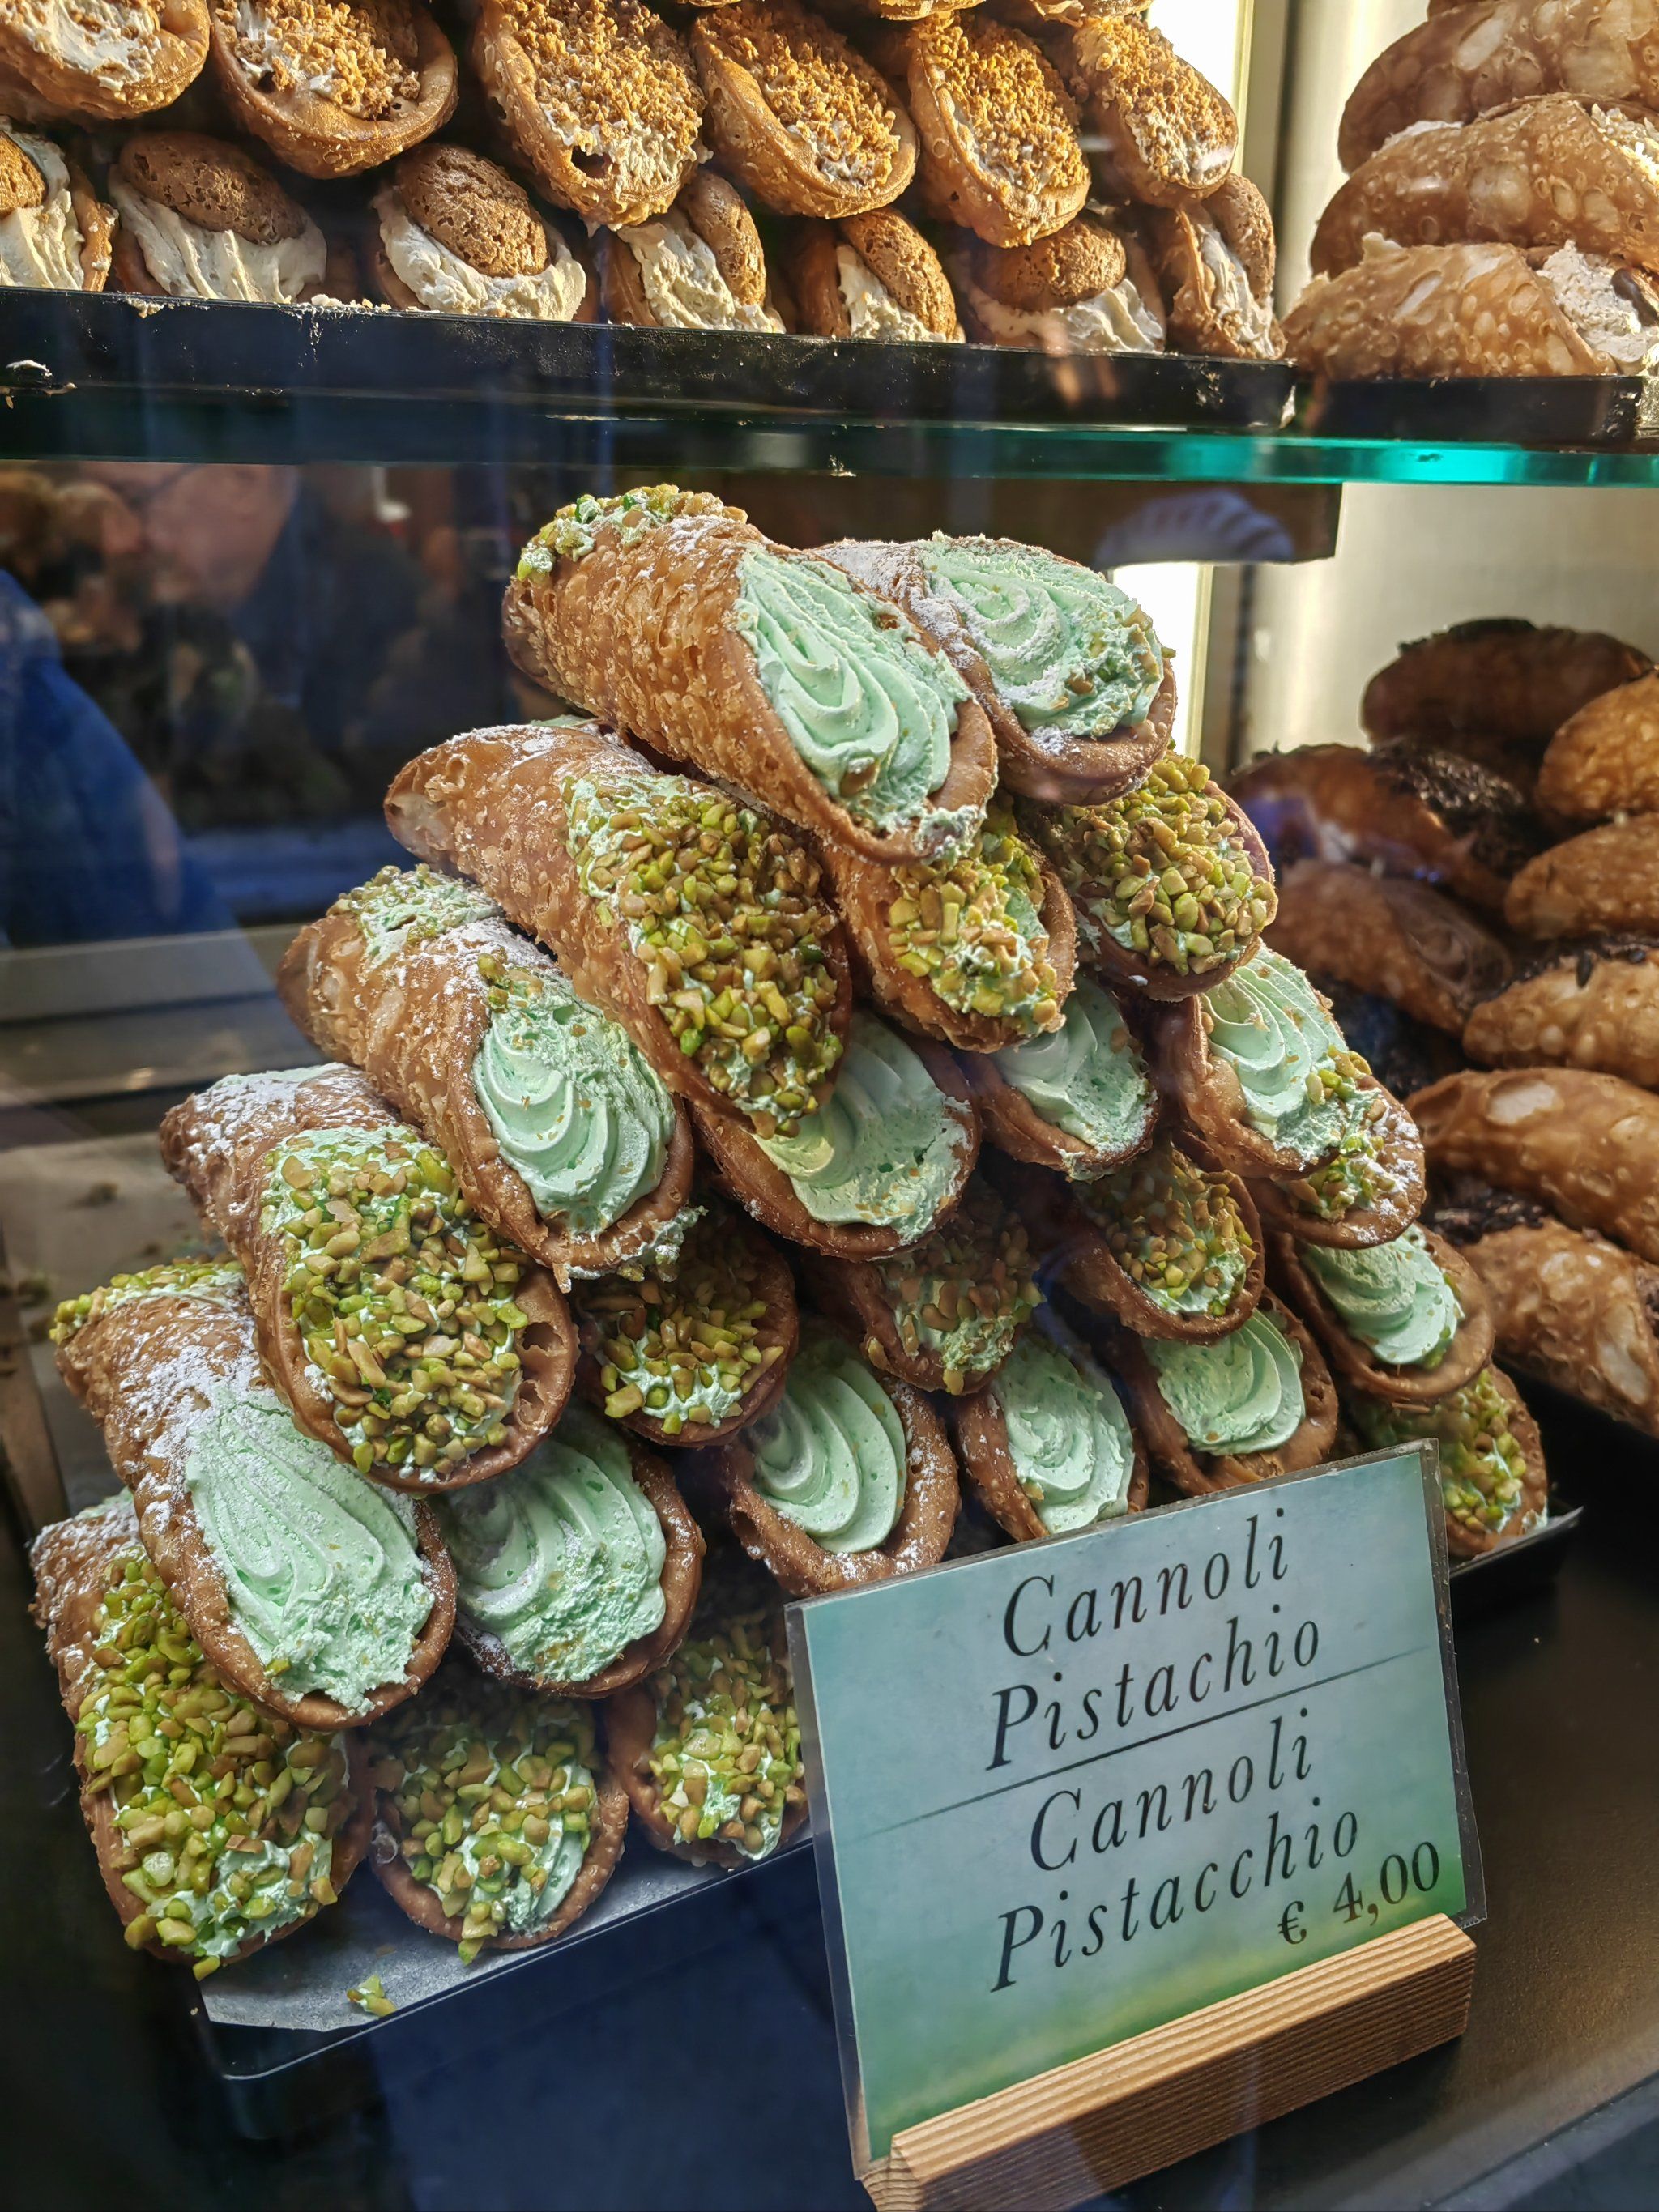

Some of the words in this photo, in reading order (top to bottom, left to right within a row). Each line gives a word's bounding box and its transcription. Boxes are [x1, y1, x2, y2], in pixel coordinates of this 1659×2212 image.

[1003, 1507, 1289, 1656] Cannoli
[986, 1604, 1320, 1771] Pistachio
[1030, 1708, 1312, 1871] Cannoli
[990, 1796, 1358, 1993] Pistacchio
[1277, 1900, 1307, 1945] €
[1333, 1840, 1440, 1924] 4,00
